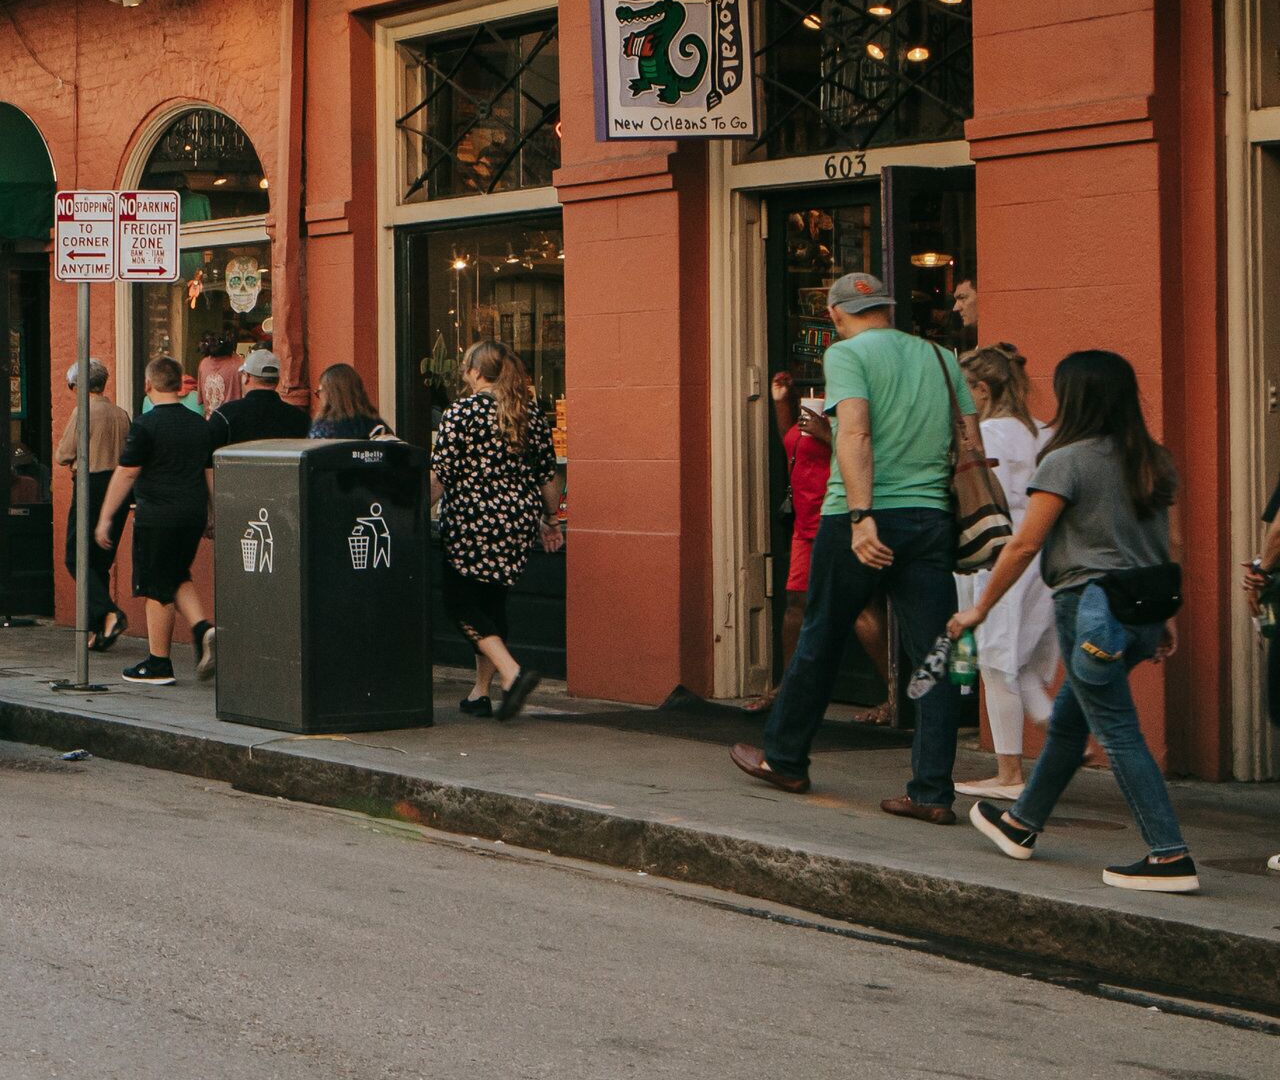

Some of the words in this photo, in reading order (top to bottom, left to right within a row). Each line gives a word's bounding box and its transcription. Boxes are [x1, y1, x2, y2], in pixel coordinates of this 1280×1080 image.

[614, 118, 644, 131] New
[650, 116, 707, 131] Orleans
[711, 117, 726, 129] To
[730, 116, 747, 130] Go
[824, 153, 867, 179] 603
[58, 199, 74, 216] NO
[75, 202, 113, 213] STOPPING
[120, 199, 136, 216] NO
[137, 202, 176, 213] PARKING
[79, 223, 93, 234] TO
[123, 223, 173, 235] FREIGHT
[62, 237, 109, 247] CORNER
[132, 238, 163, 249] ZONE
[153, 257, 164, 265] FRI
